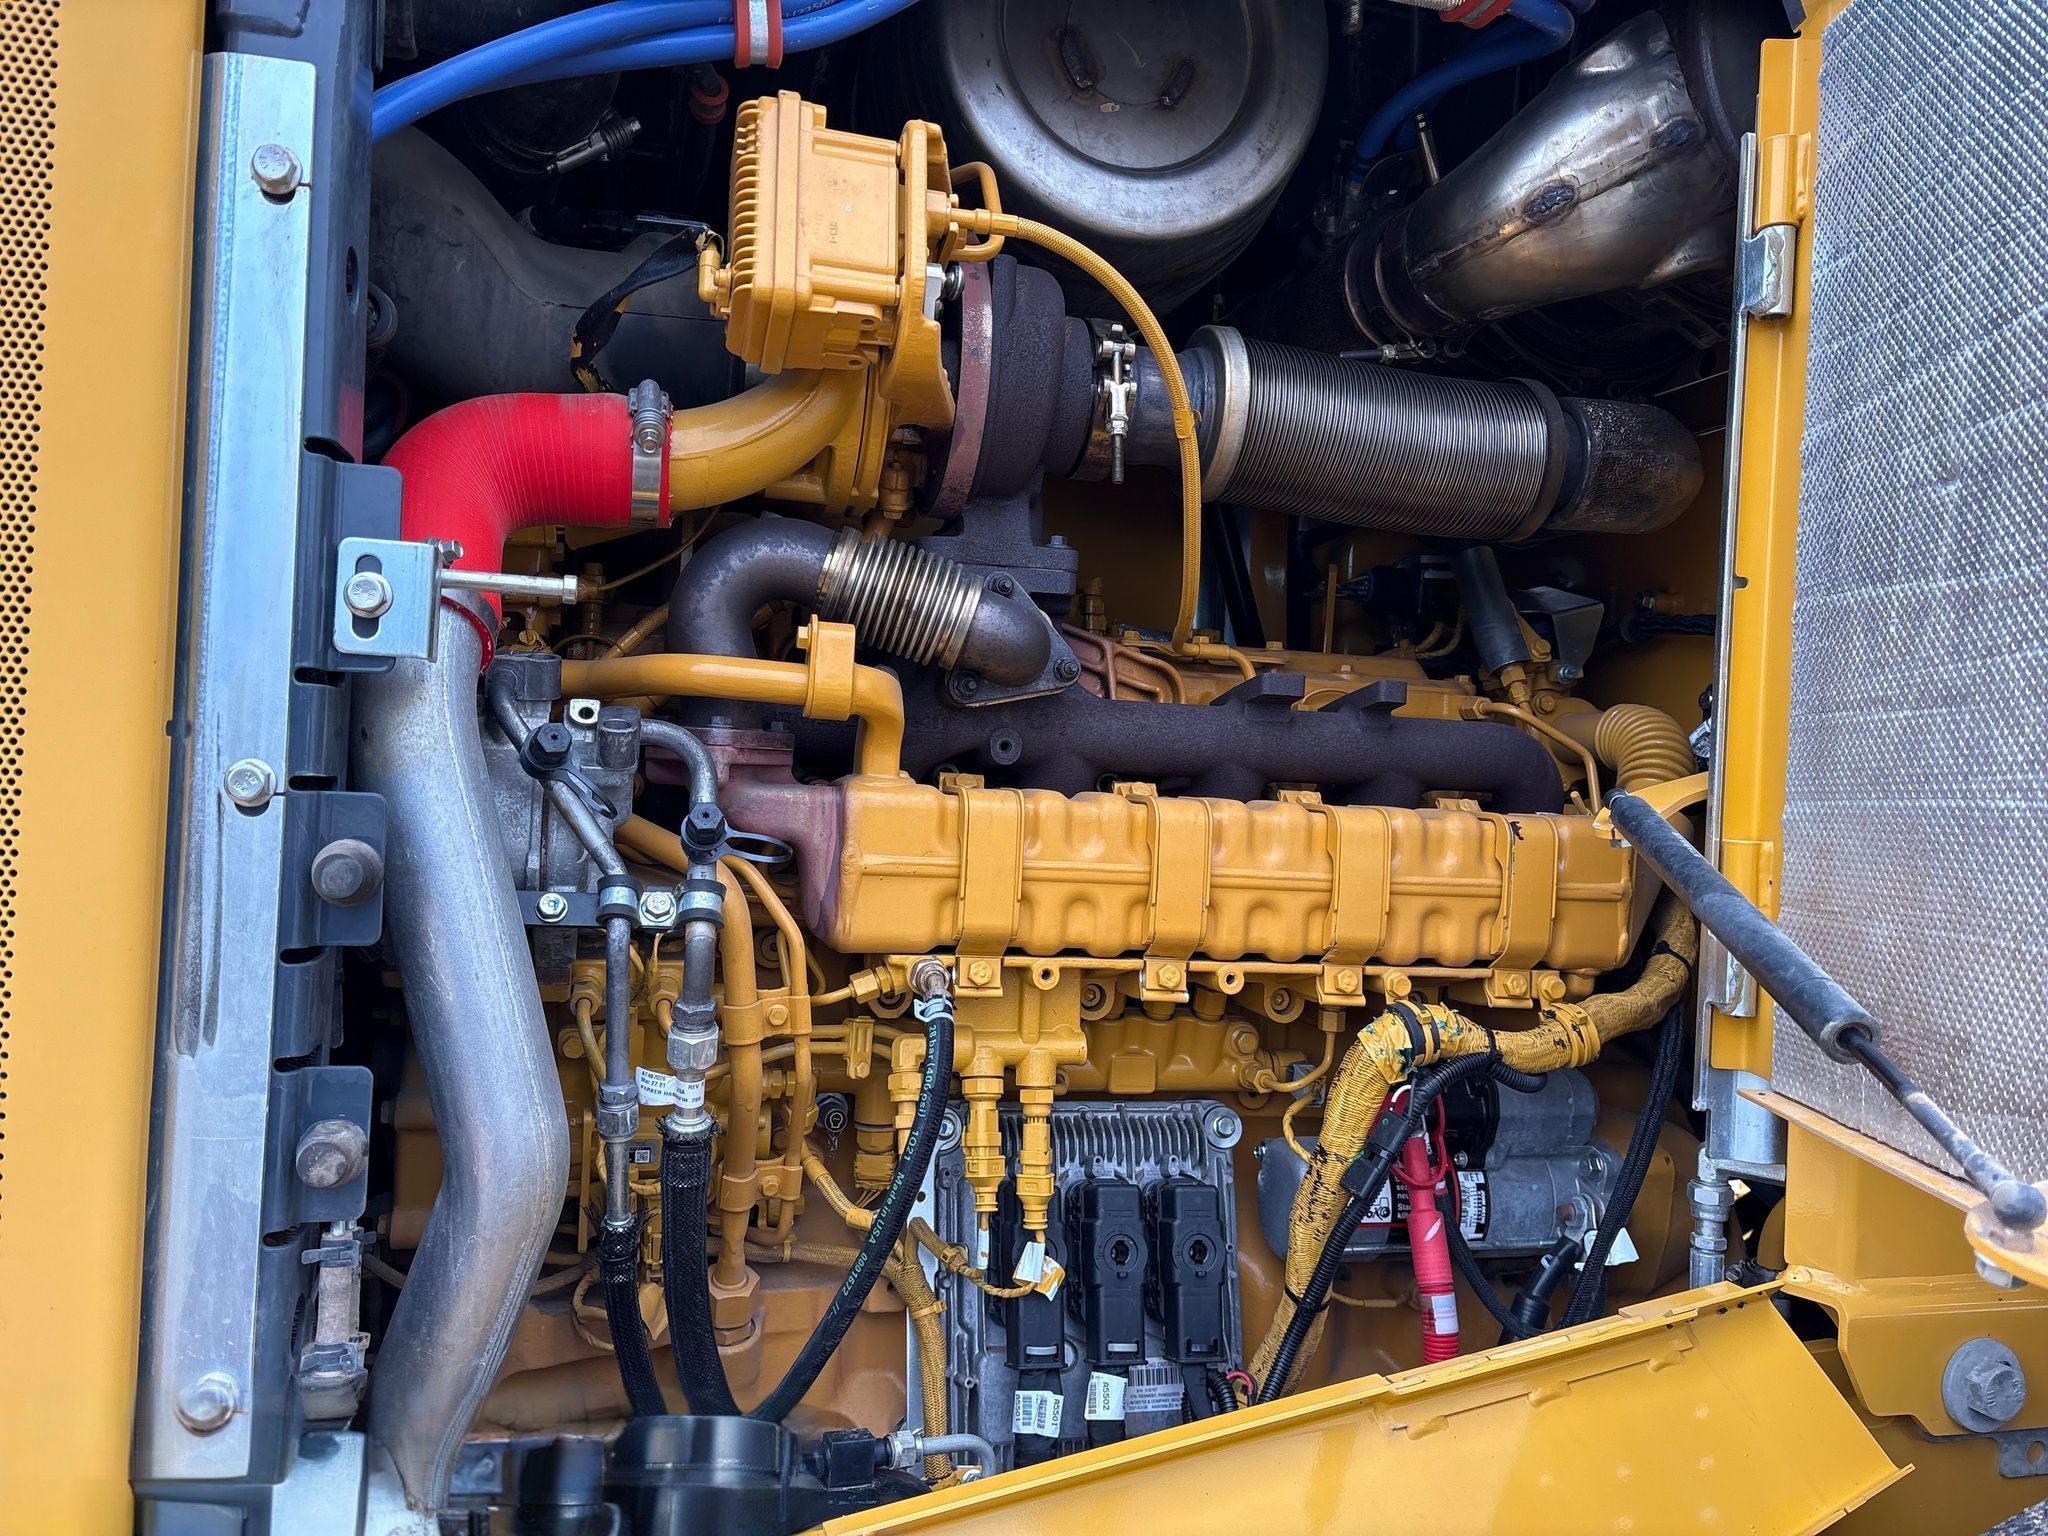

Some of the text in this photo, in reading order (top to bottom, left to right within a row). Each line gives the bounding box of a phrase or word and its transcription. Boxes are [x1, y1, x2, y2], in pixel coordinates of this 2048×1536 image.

[928, 1024, 937, 1039] 28
[928, 1038, 937, 1060] bar
[641, 1084, 662, 1095] PARKER
[917, 1092, 928, 1118] psi)
[887, 1171, 905, 1206] Made
[1462, 1172, 1480, 1181] WET
[880, 1205, 890, 1218] in
[868, 1218, 885, 1245] USA
[842, 1252, 868, 1296] 0001672
[1102, 1381, 1110, 1411] A5502
[1051, 1398, 1061, 1426] A5501
